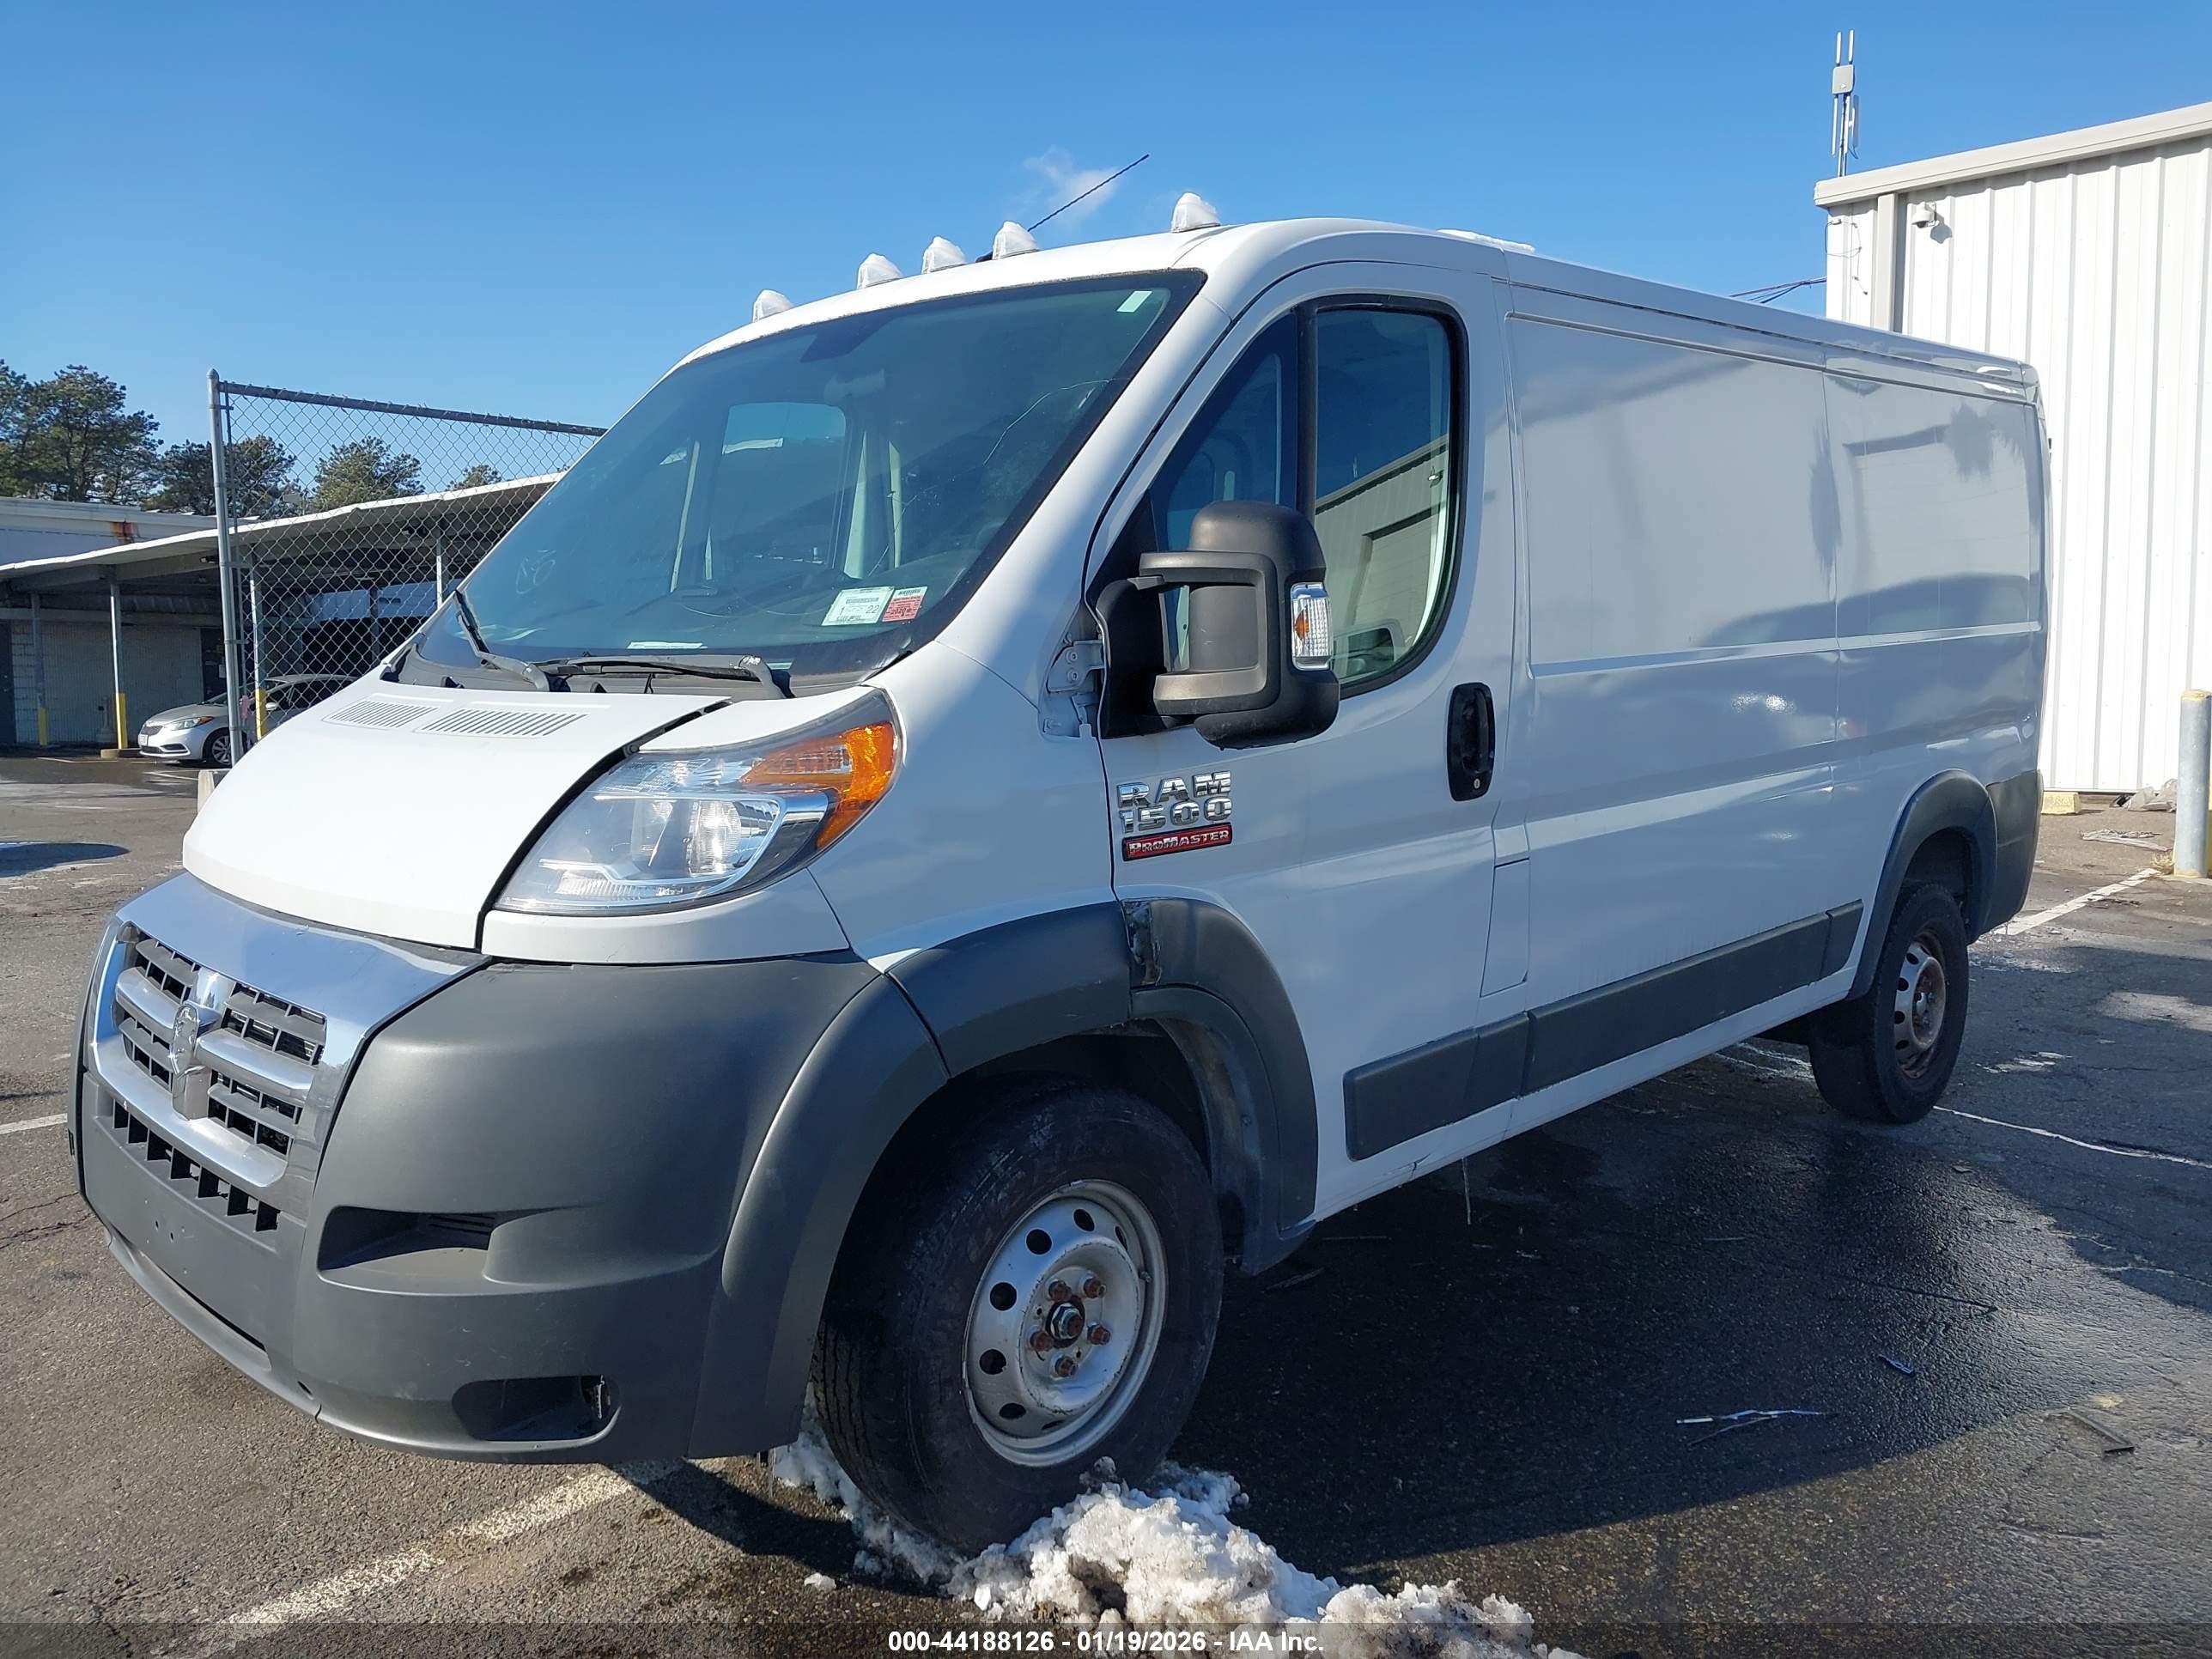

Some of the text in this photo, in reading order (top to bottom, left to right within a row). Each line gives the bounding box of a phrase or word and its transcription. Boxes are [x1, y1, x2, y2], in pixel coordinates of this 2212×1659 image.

[865, 605, 880, 614] 22
[1116, 770, 1231, 808] RAM
[1118, 796, 1232, 834] 1500
